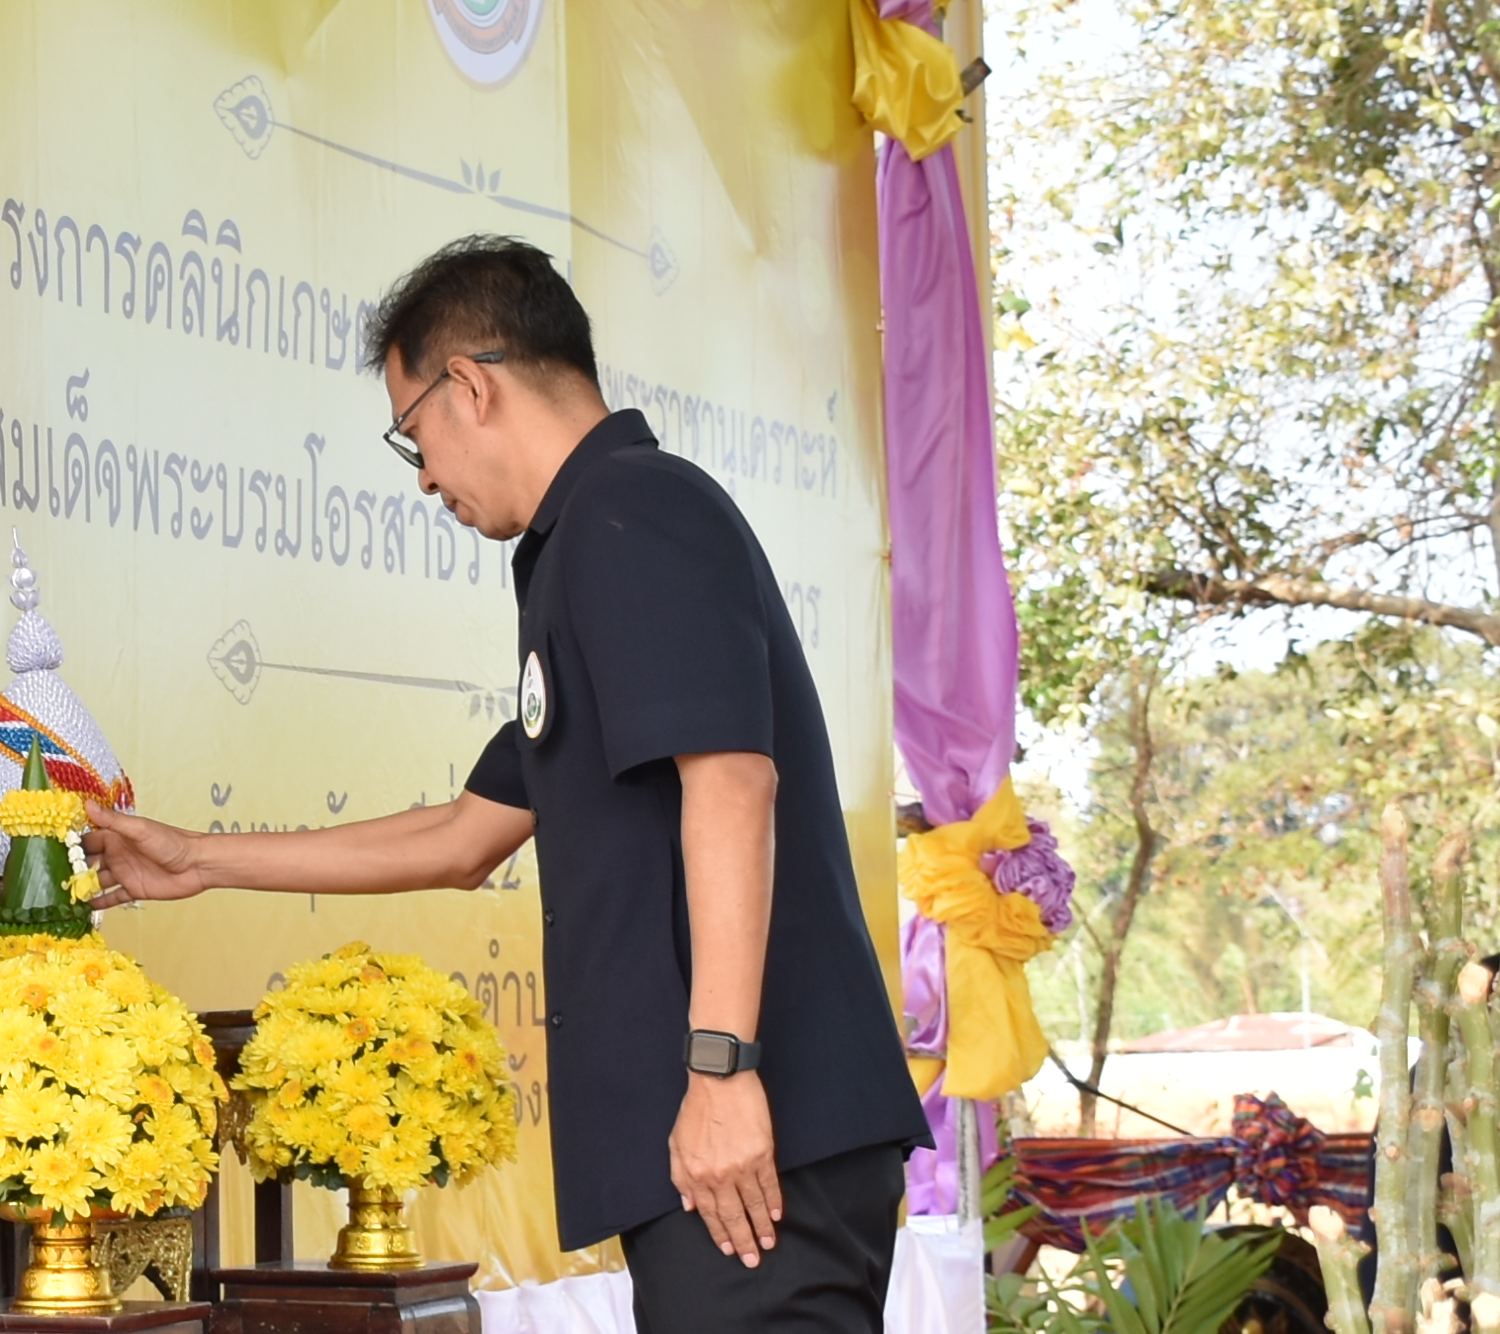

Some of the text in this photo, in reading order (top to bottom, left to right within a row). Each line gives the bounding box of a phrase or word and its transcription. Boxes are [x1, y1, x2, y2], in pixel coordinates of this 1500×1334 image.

[600, 360, 838, 501] พระราชานุเคราะห์
